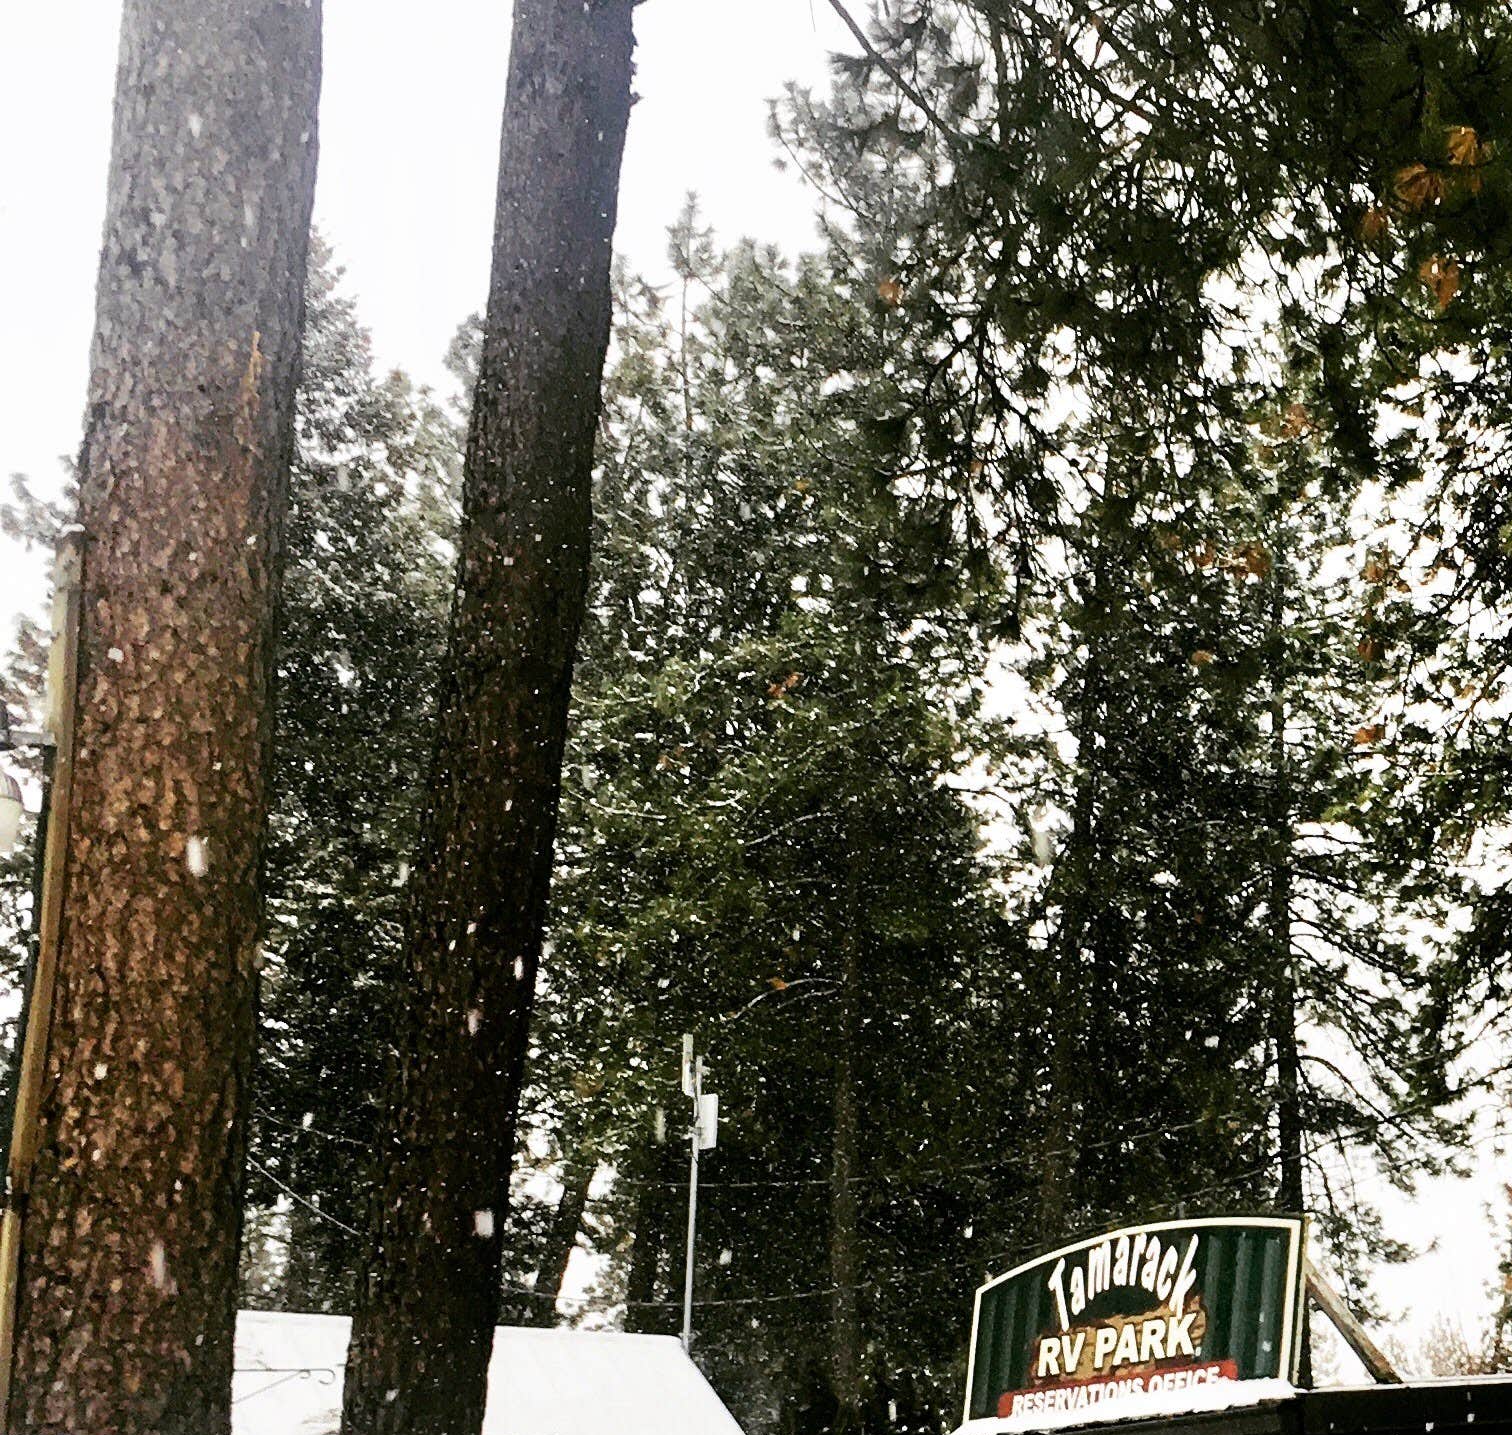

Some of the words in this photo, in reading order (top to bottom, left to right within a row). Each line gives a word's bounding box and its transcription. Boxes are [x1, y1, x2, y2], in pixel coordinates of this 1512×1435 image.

[1048, 1232, 1199, 1332] Tamarack
[1037, 1333, 1086, 1377] RV
[1094, 1312, 1198, 1369] PARK
[1012, 1377, 1144, 1418] RESERVATIONS
